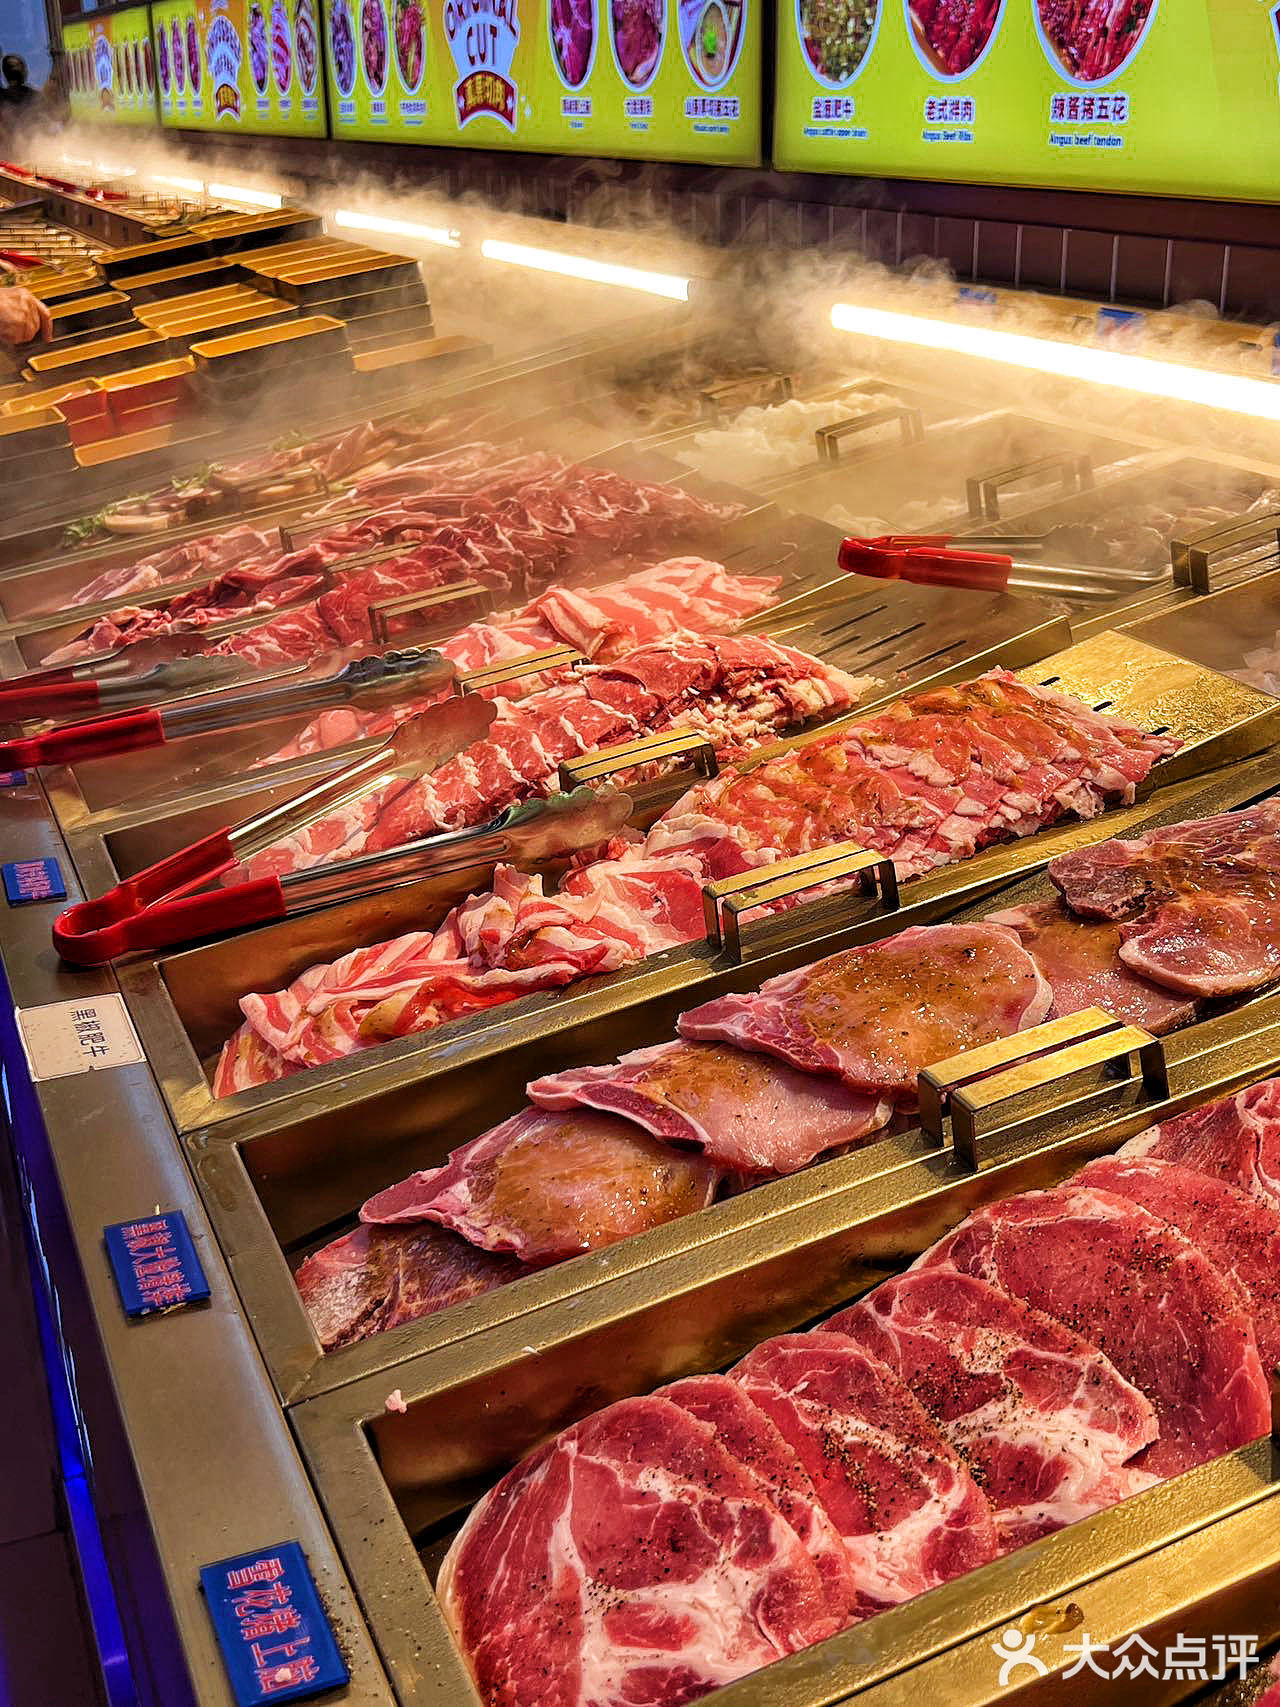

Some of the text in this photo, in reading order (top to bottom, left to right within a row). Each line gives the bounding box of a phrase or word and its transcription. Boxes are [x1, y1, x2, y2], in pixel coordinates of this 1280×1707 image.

[1049, 132, 1073, 147] Angus
[1074, 133, 1092, 146] beef
[70, 1008, 110, 1058] 黑椒肥牛
